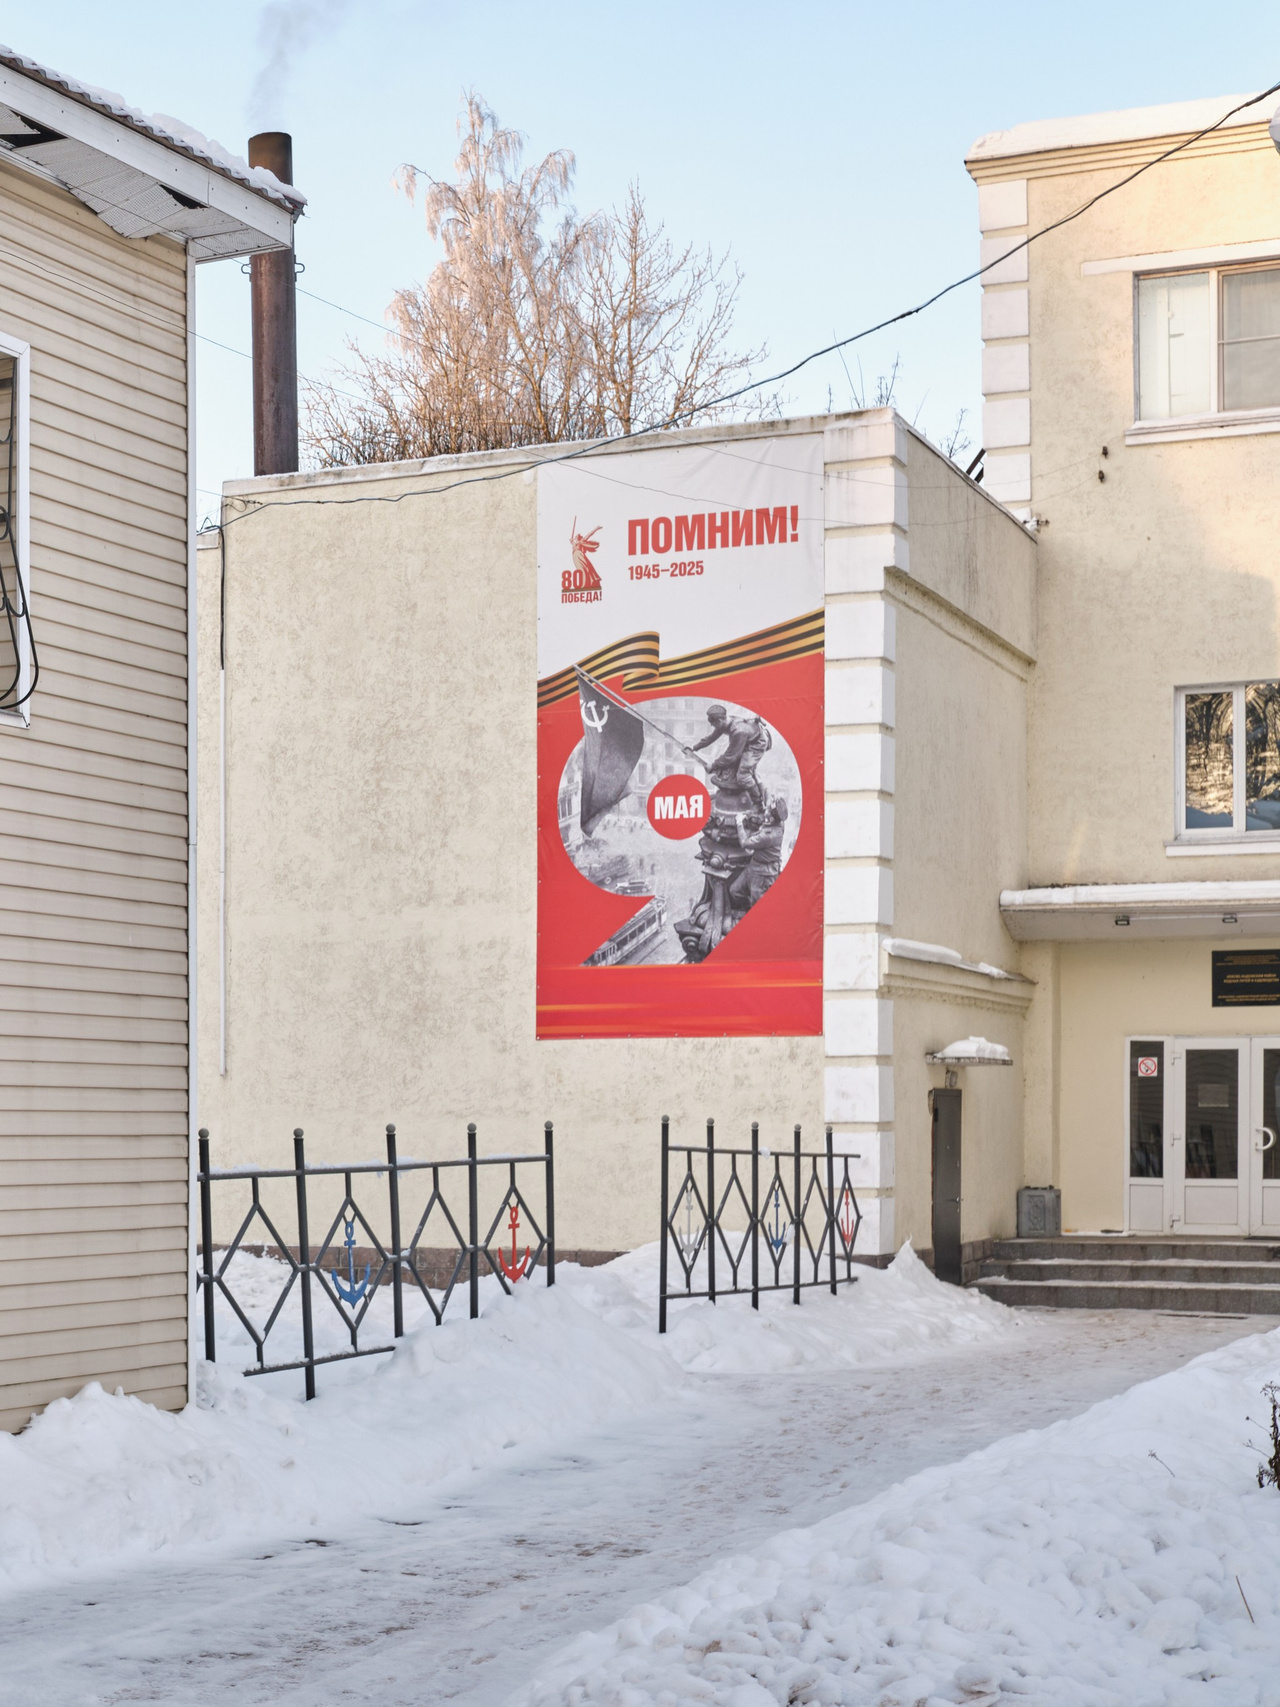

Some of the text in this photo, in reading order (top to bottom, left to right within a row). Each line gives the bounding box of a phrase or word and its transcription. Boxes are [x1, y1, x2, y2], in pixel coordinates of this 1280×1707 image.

[628, 505, 799, 556] ПОМНИМ!
[561, 569, 584, 590] 80
[561, 590, 602, 603] ПОБЕДА!
[654, 794, 704, 820] МАЯ
